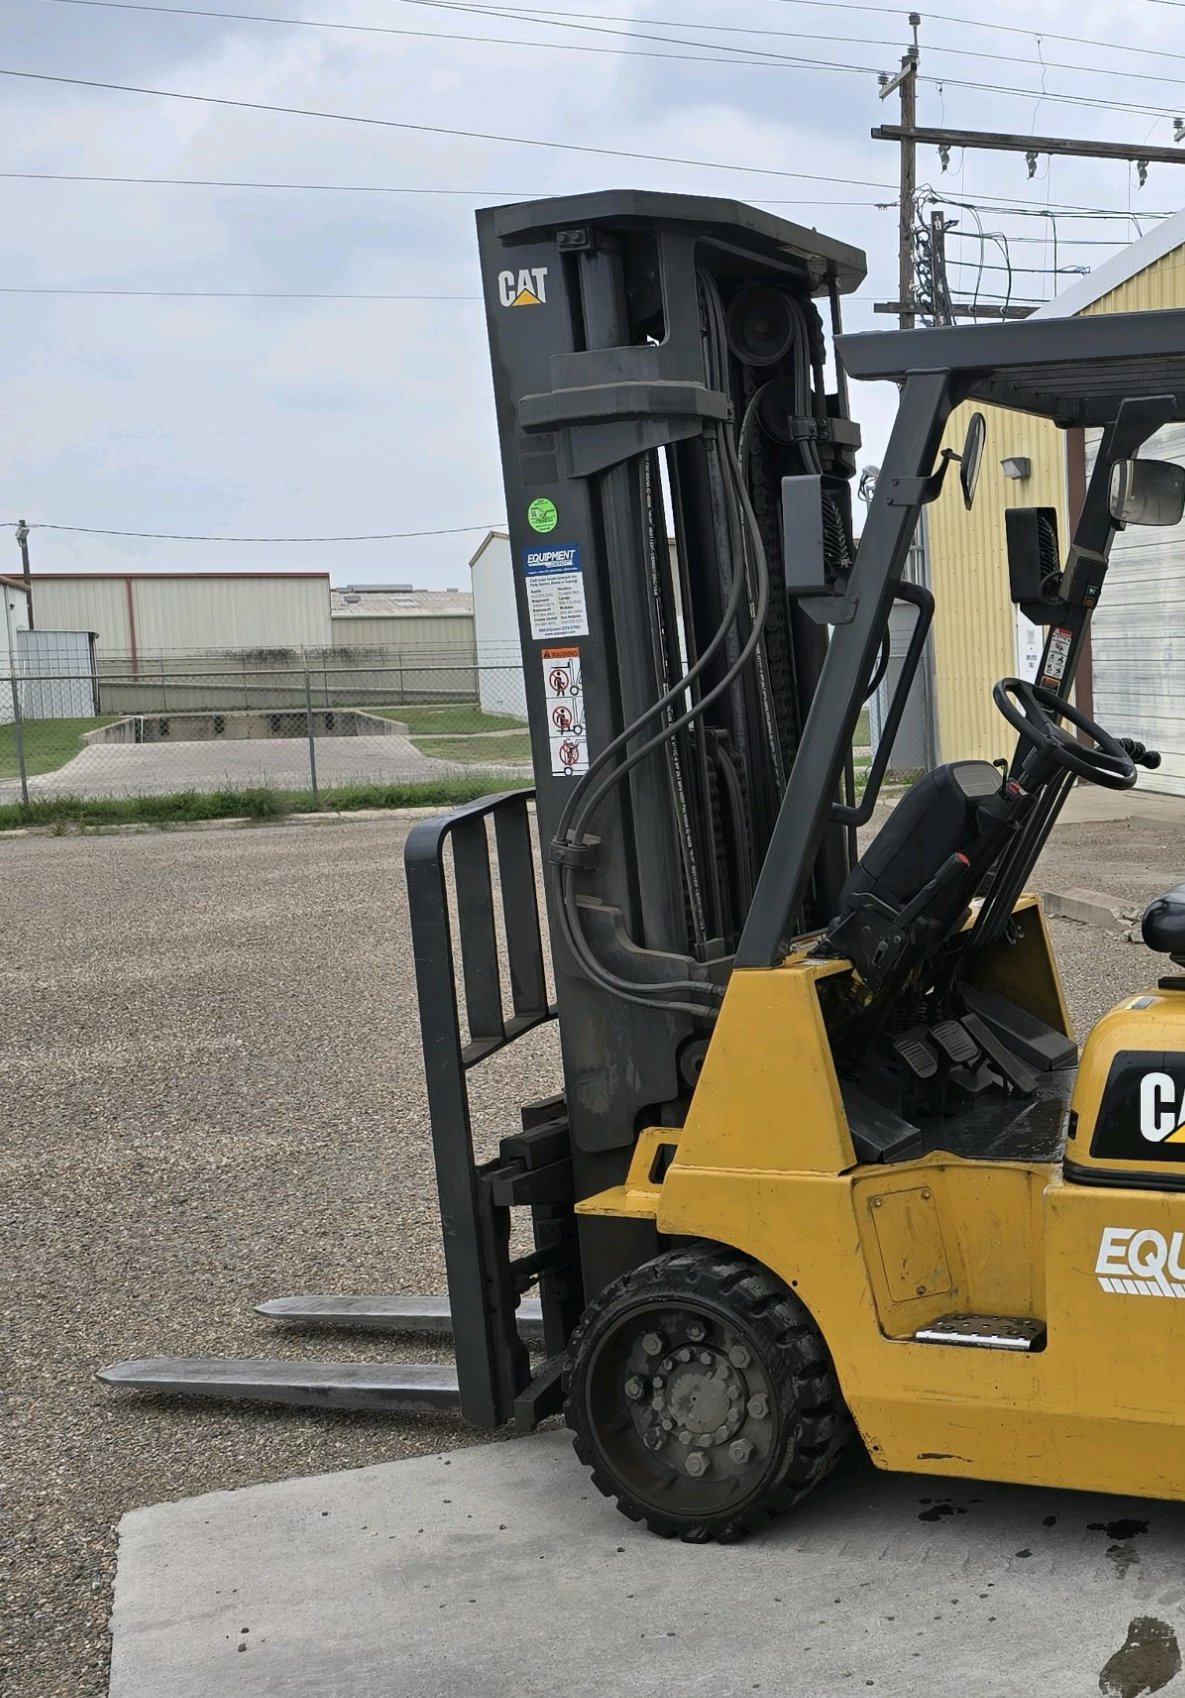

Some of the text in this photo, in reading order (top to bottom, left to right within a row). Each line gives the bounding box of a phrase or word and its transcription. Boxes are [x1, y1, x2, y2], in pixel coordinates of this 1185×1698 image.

[497, 267, 548, 307] CAT
[527, 550, 576, 564] EQUIPMENT
[550, 650, 578, 658] WARNING
